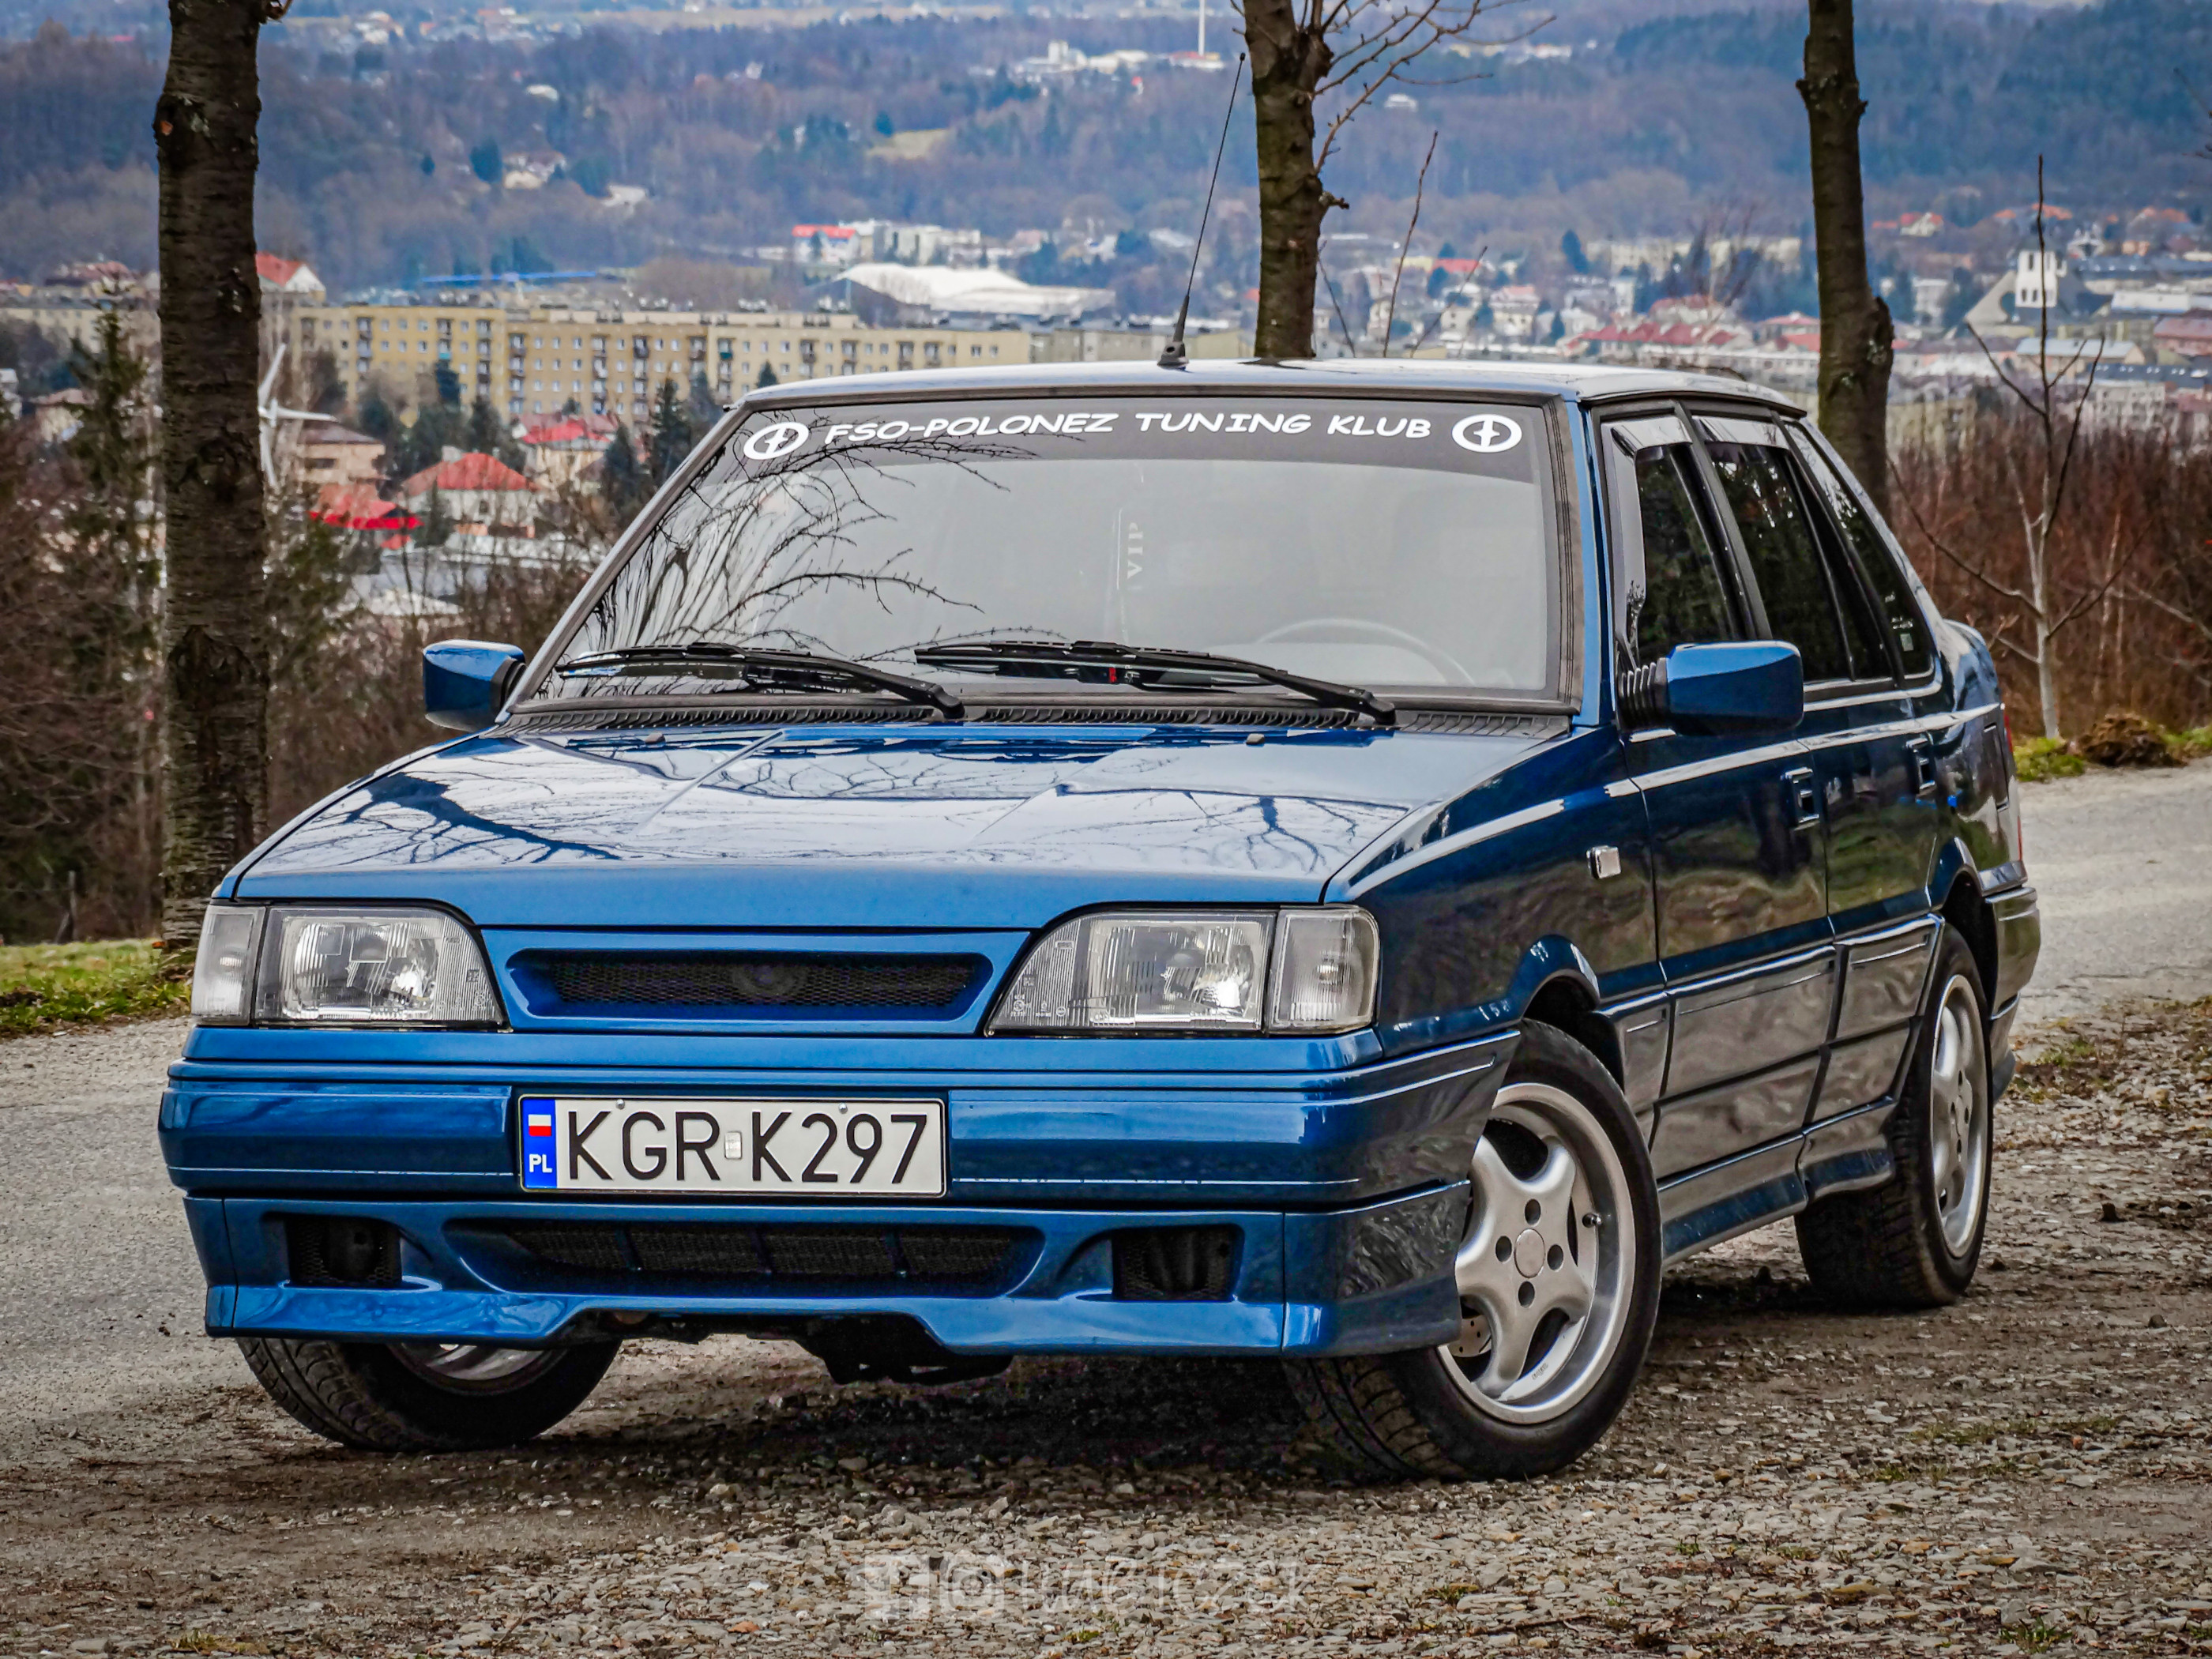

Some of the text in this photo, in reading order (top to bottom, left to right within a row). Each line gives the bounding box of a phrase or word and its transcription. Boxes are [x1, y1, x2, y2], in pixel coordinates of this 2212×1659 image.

[824, 412, 1431, 445] FSO-POLONEZ TUNING KLUB
[1127, 521, 1144, 579] VIP
[529, 1153, 553, 1173] PL
[567, 1110, 928, 1184] KGR K297
